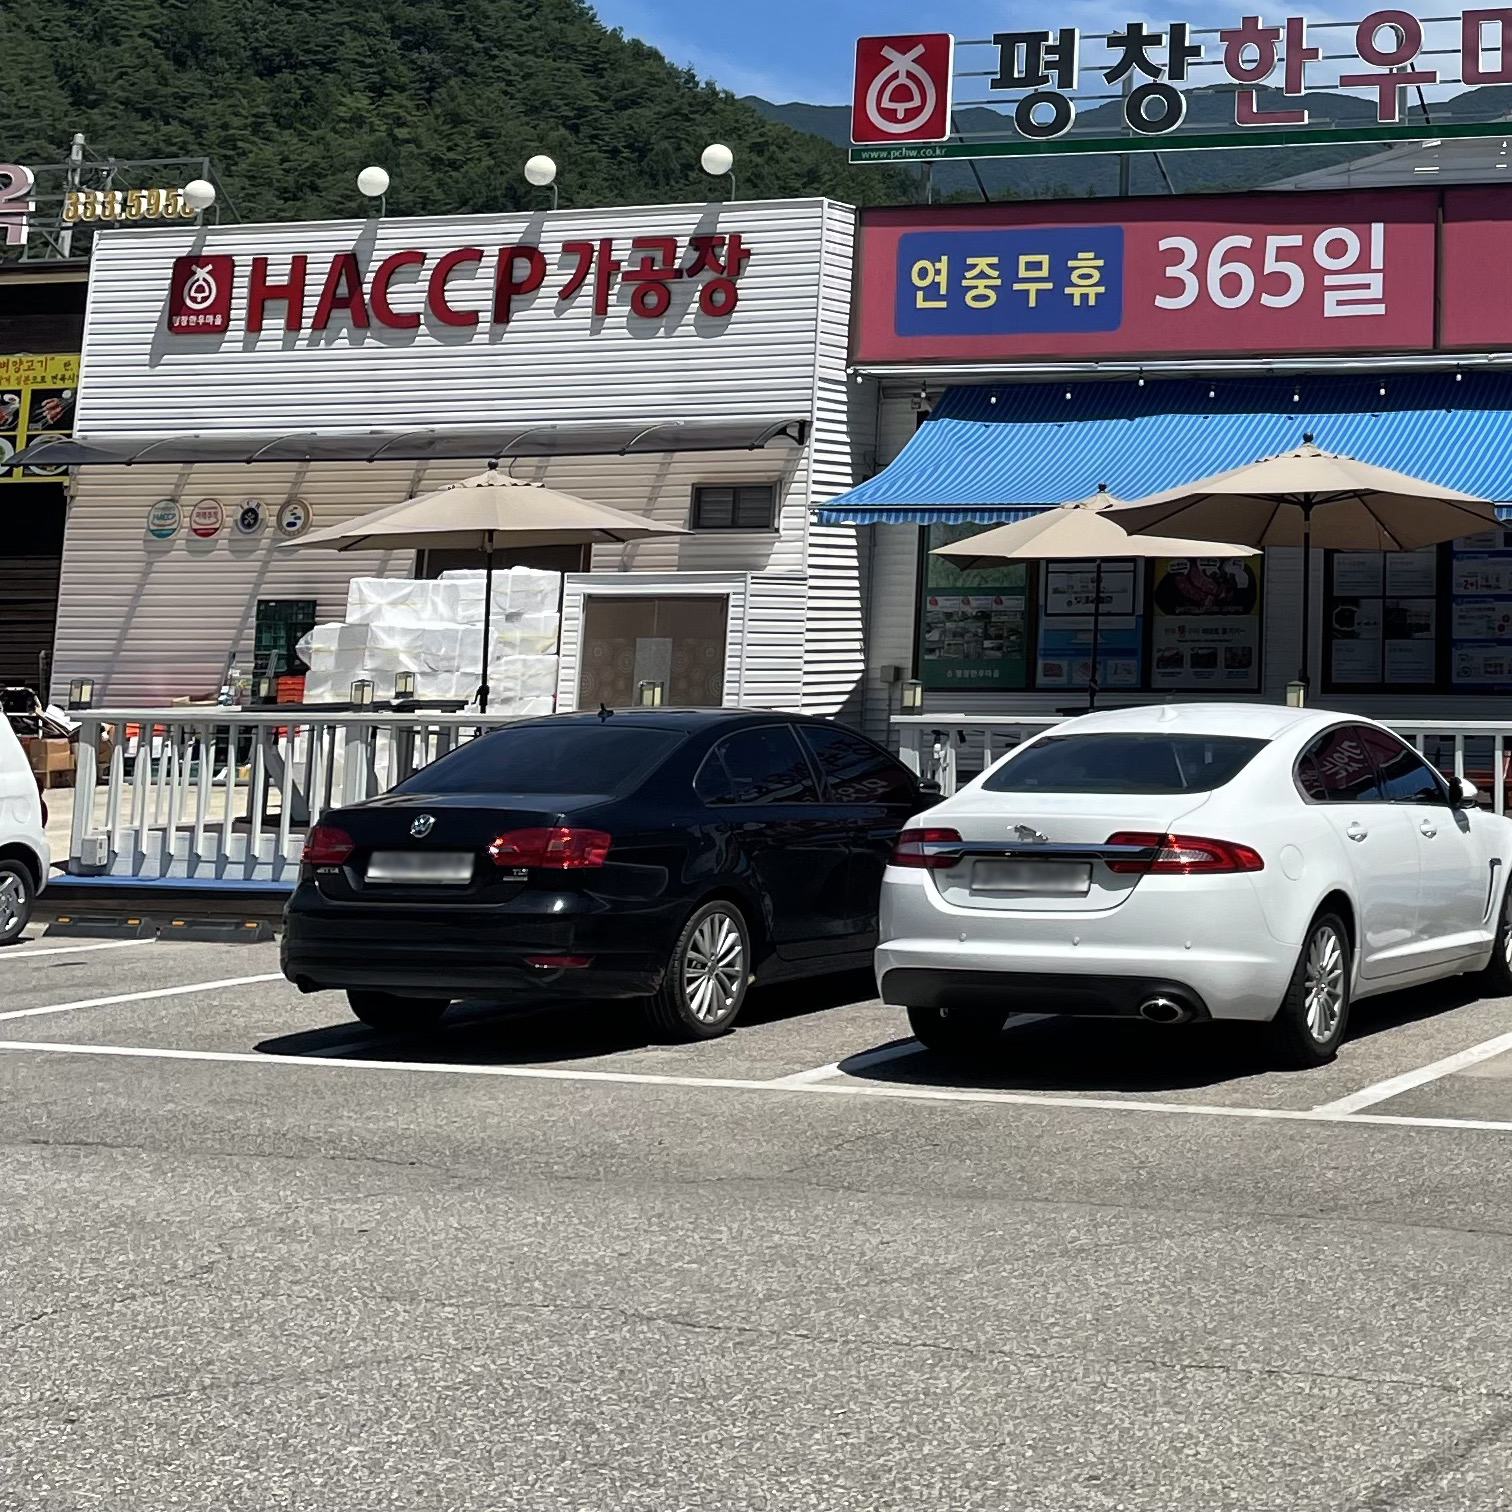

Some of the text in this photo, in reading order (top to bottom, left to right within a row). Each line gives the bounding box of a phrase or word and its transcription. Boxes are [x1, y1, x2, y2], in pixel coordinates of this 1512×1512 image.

[861, 146, 948, 160] www.pchw.co.kr
[910, 250, 1107, 309] 연중무휴
[1153, 221, 1388, 319] 365일
